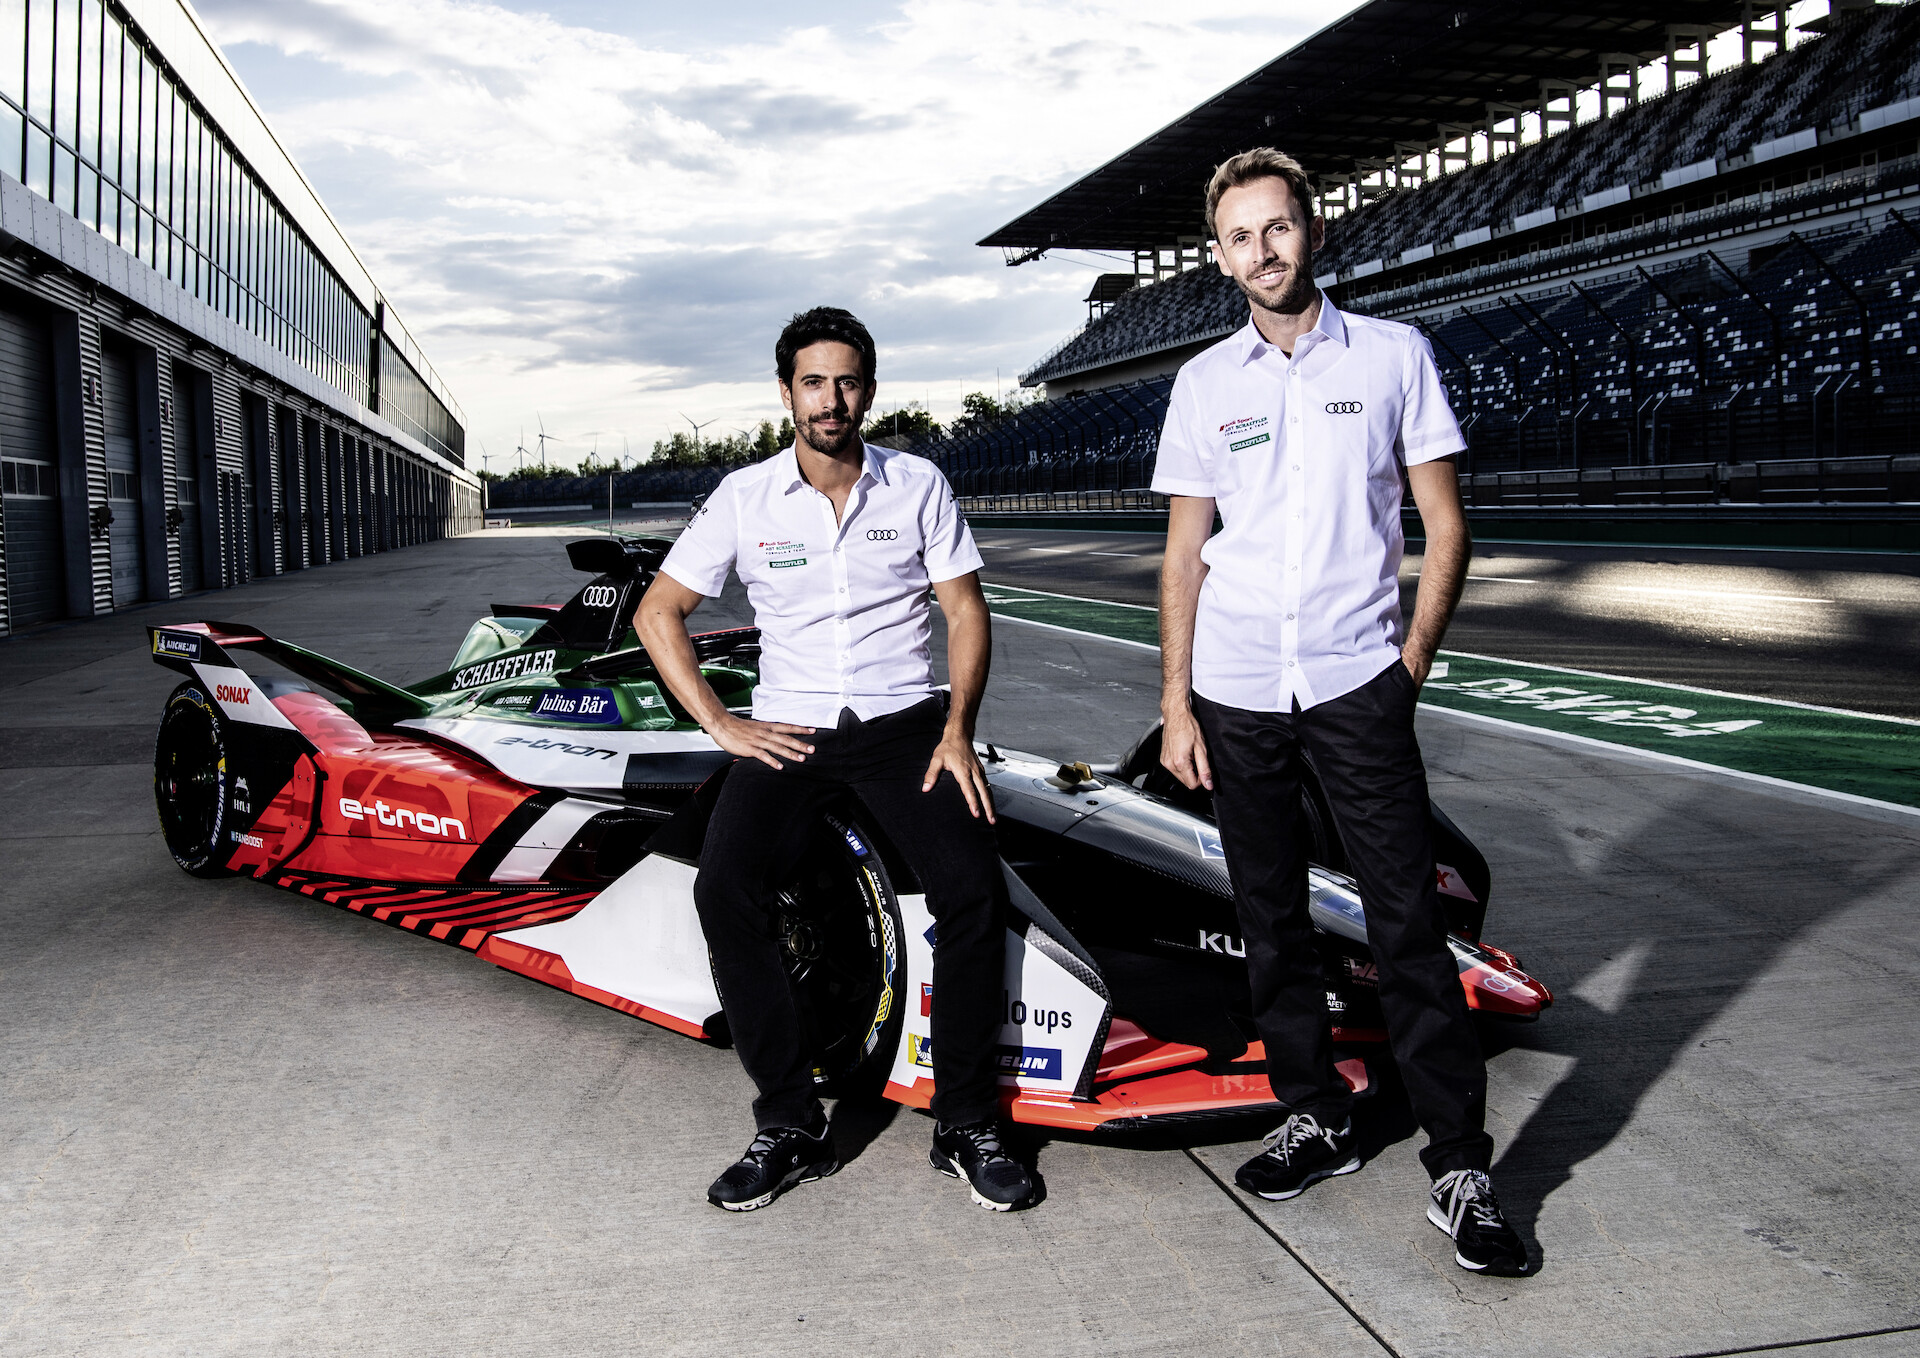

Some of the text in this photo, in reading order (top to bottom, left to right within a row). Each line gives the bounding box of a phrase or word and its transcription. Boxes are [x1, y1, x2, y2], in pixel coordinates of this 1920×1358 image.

[1231, 435, 1267, 451] SCHAEFFLER
[166, 640, 198, 653] MICHELIN
[451, 649, 556, 690] SCHAEFFLER
[216, 684, 251, 705] SONAX
[536, 694, 608, 714] Julius Bär
[493, 736, 618, 760] e-tron
[210, 785, 225, 847] MICHELIN
[339, 798, 467, 840] e-tron
[823, 812, 862, 851] ICHELIN
[1327, 1000, 1347, 1009] AFETY
[1034, 1009, 1072, 1034] ups
